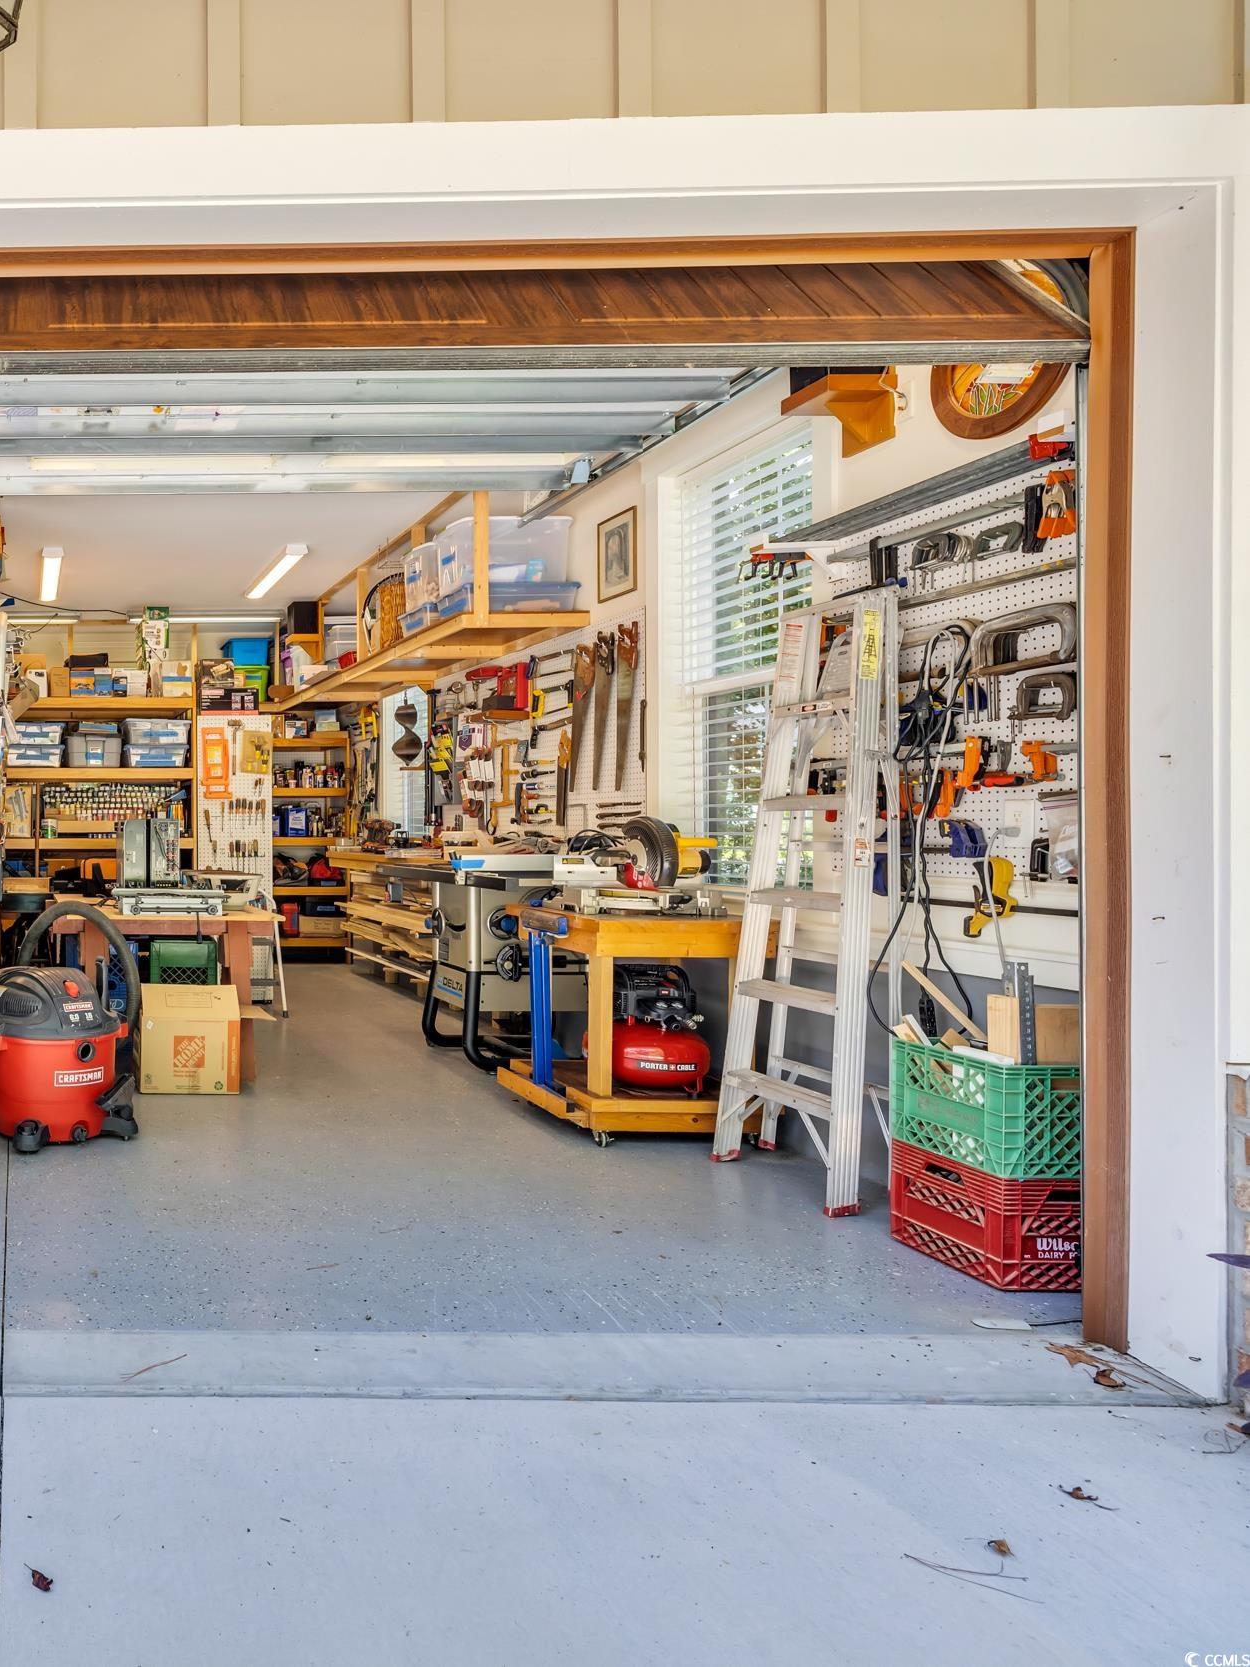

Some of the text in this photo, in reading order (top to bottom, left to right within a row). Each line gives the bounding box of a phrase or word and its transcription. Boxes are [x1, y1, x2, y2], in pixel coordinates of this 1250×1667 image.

[442, 976, 463, 992] DELTA
[64, 1003, 92, 1011] CRAFTSMAN
[640, 1061, 668, 1070] PORTER
[58, 1071, 102, 1083] CRAFTSMAN
[1038, 1251, 1065, 1259] DAIRY
